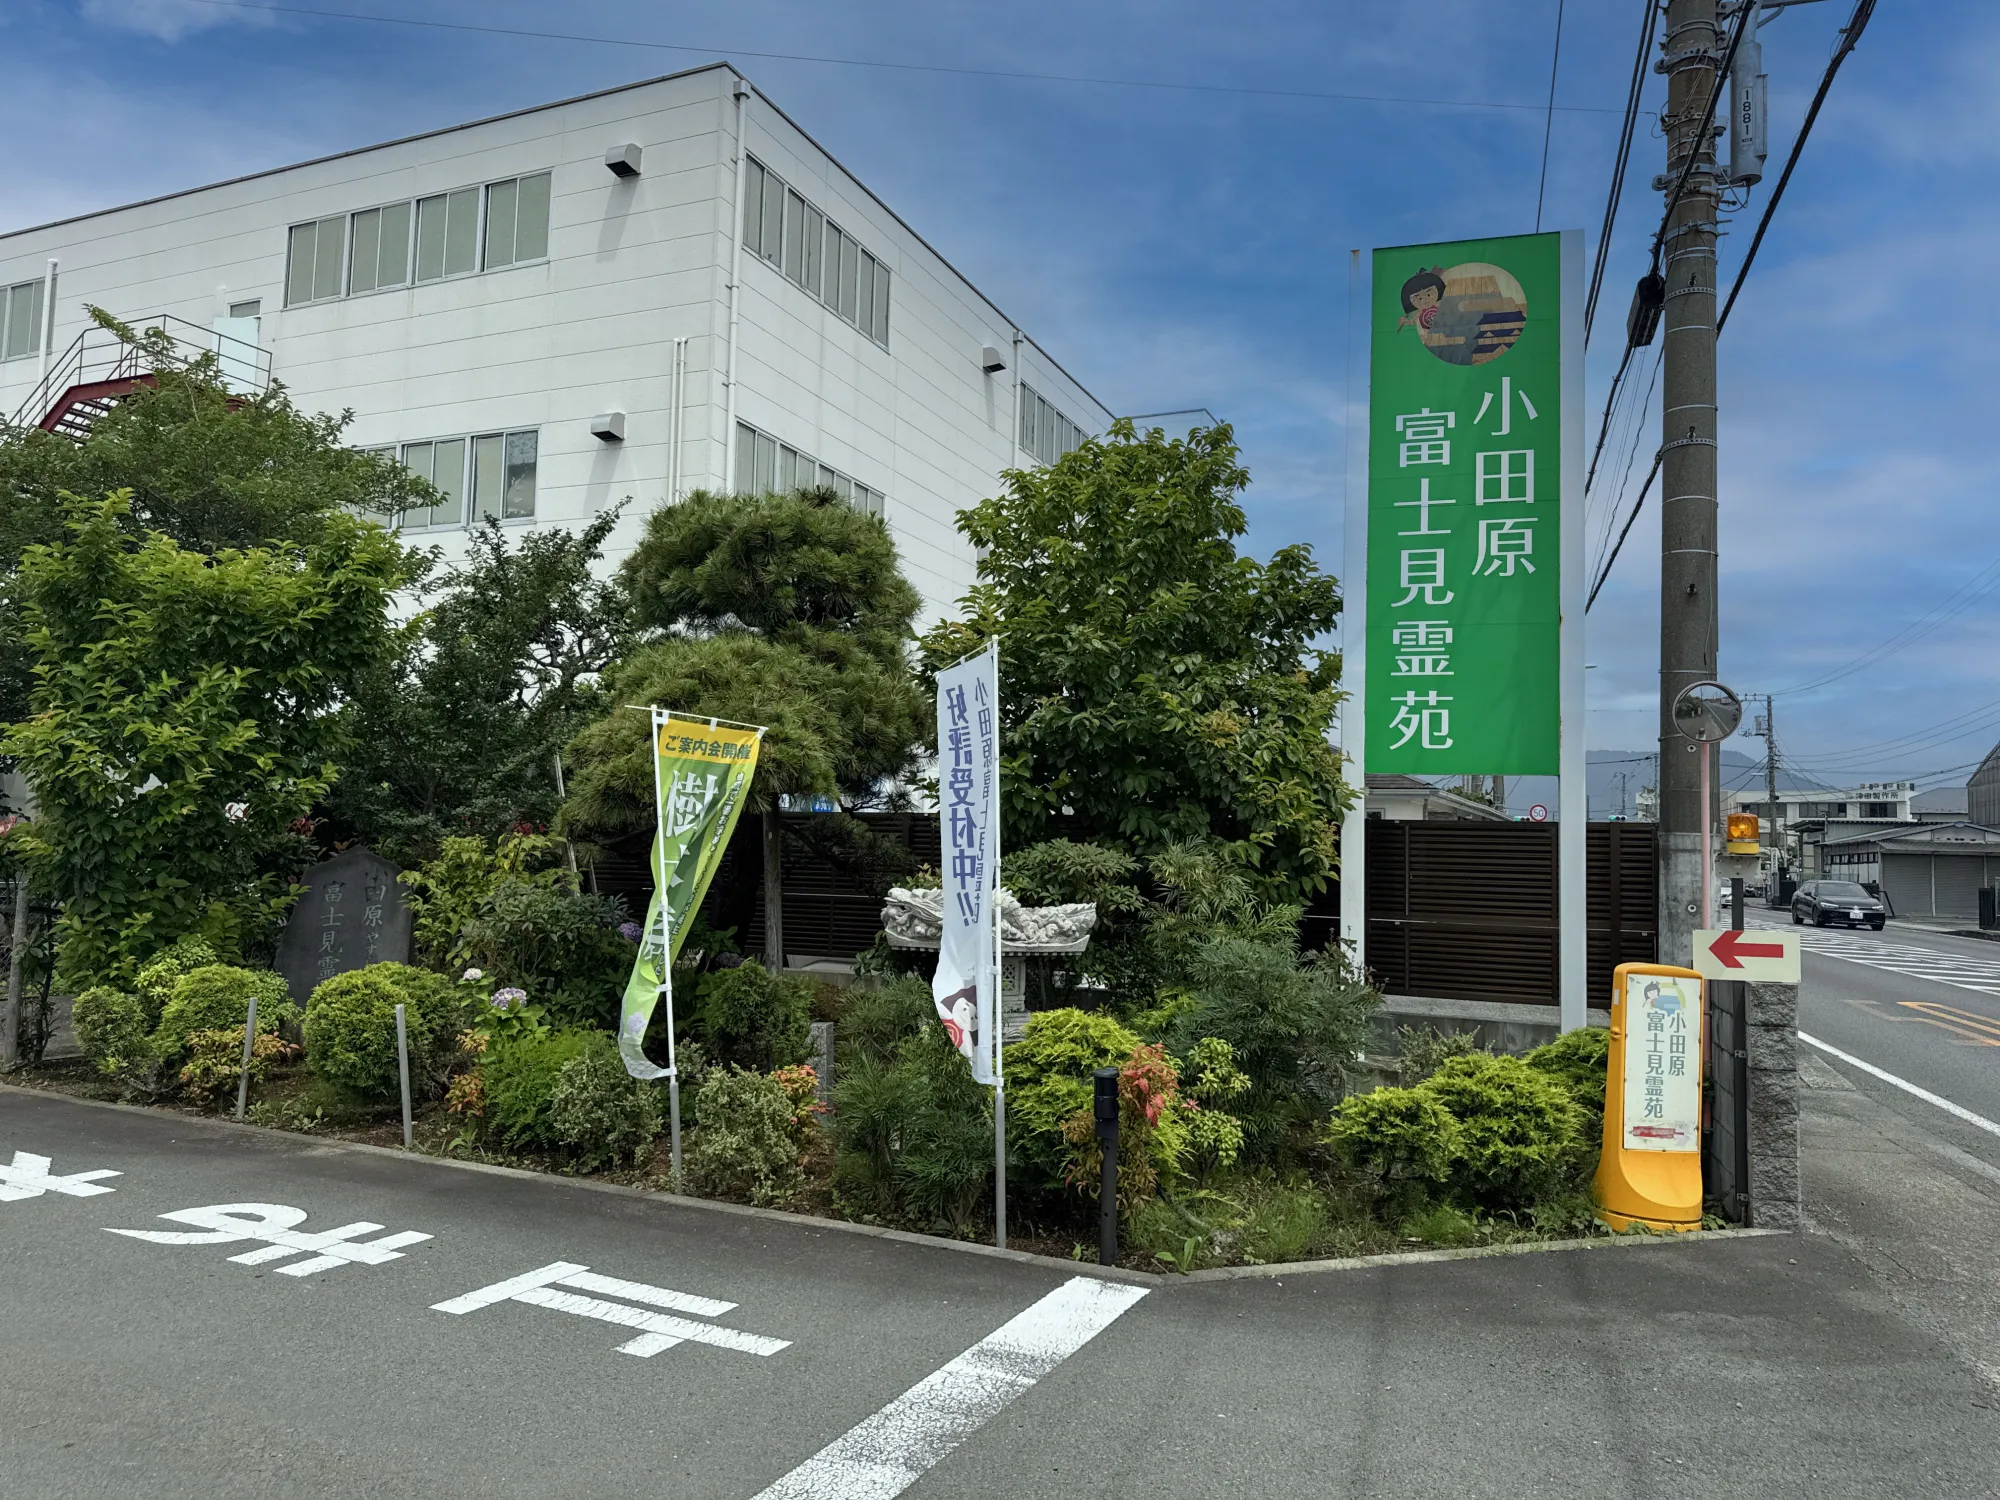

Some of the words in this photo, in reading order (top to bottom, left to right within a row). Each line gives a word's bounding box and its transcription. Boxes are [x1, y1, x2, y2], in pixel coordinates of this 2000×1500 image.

[1742, 90, 1752, 135] 1881
[1471, 376, 1539, 577] 小田原
[1388, 407, 1456, 751] 富士見霊苑
[665, 734, 752, 760] ご案内会開催
[1533, 809, 1544, 818] 50
[363, 864, 389, 965] 小田原やす
[1643, 1011, 1665, 1119] 富士見霊苑
[1668, 1012, 1686, 1077] 小田原
